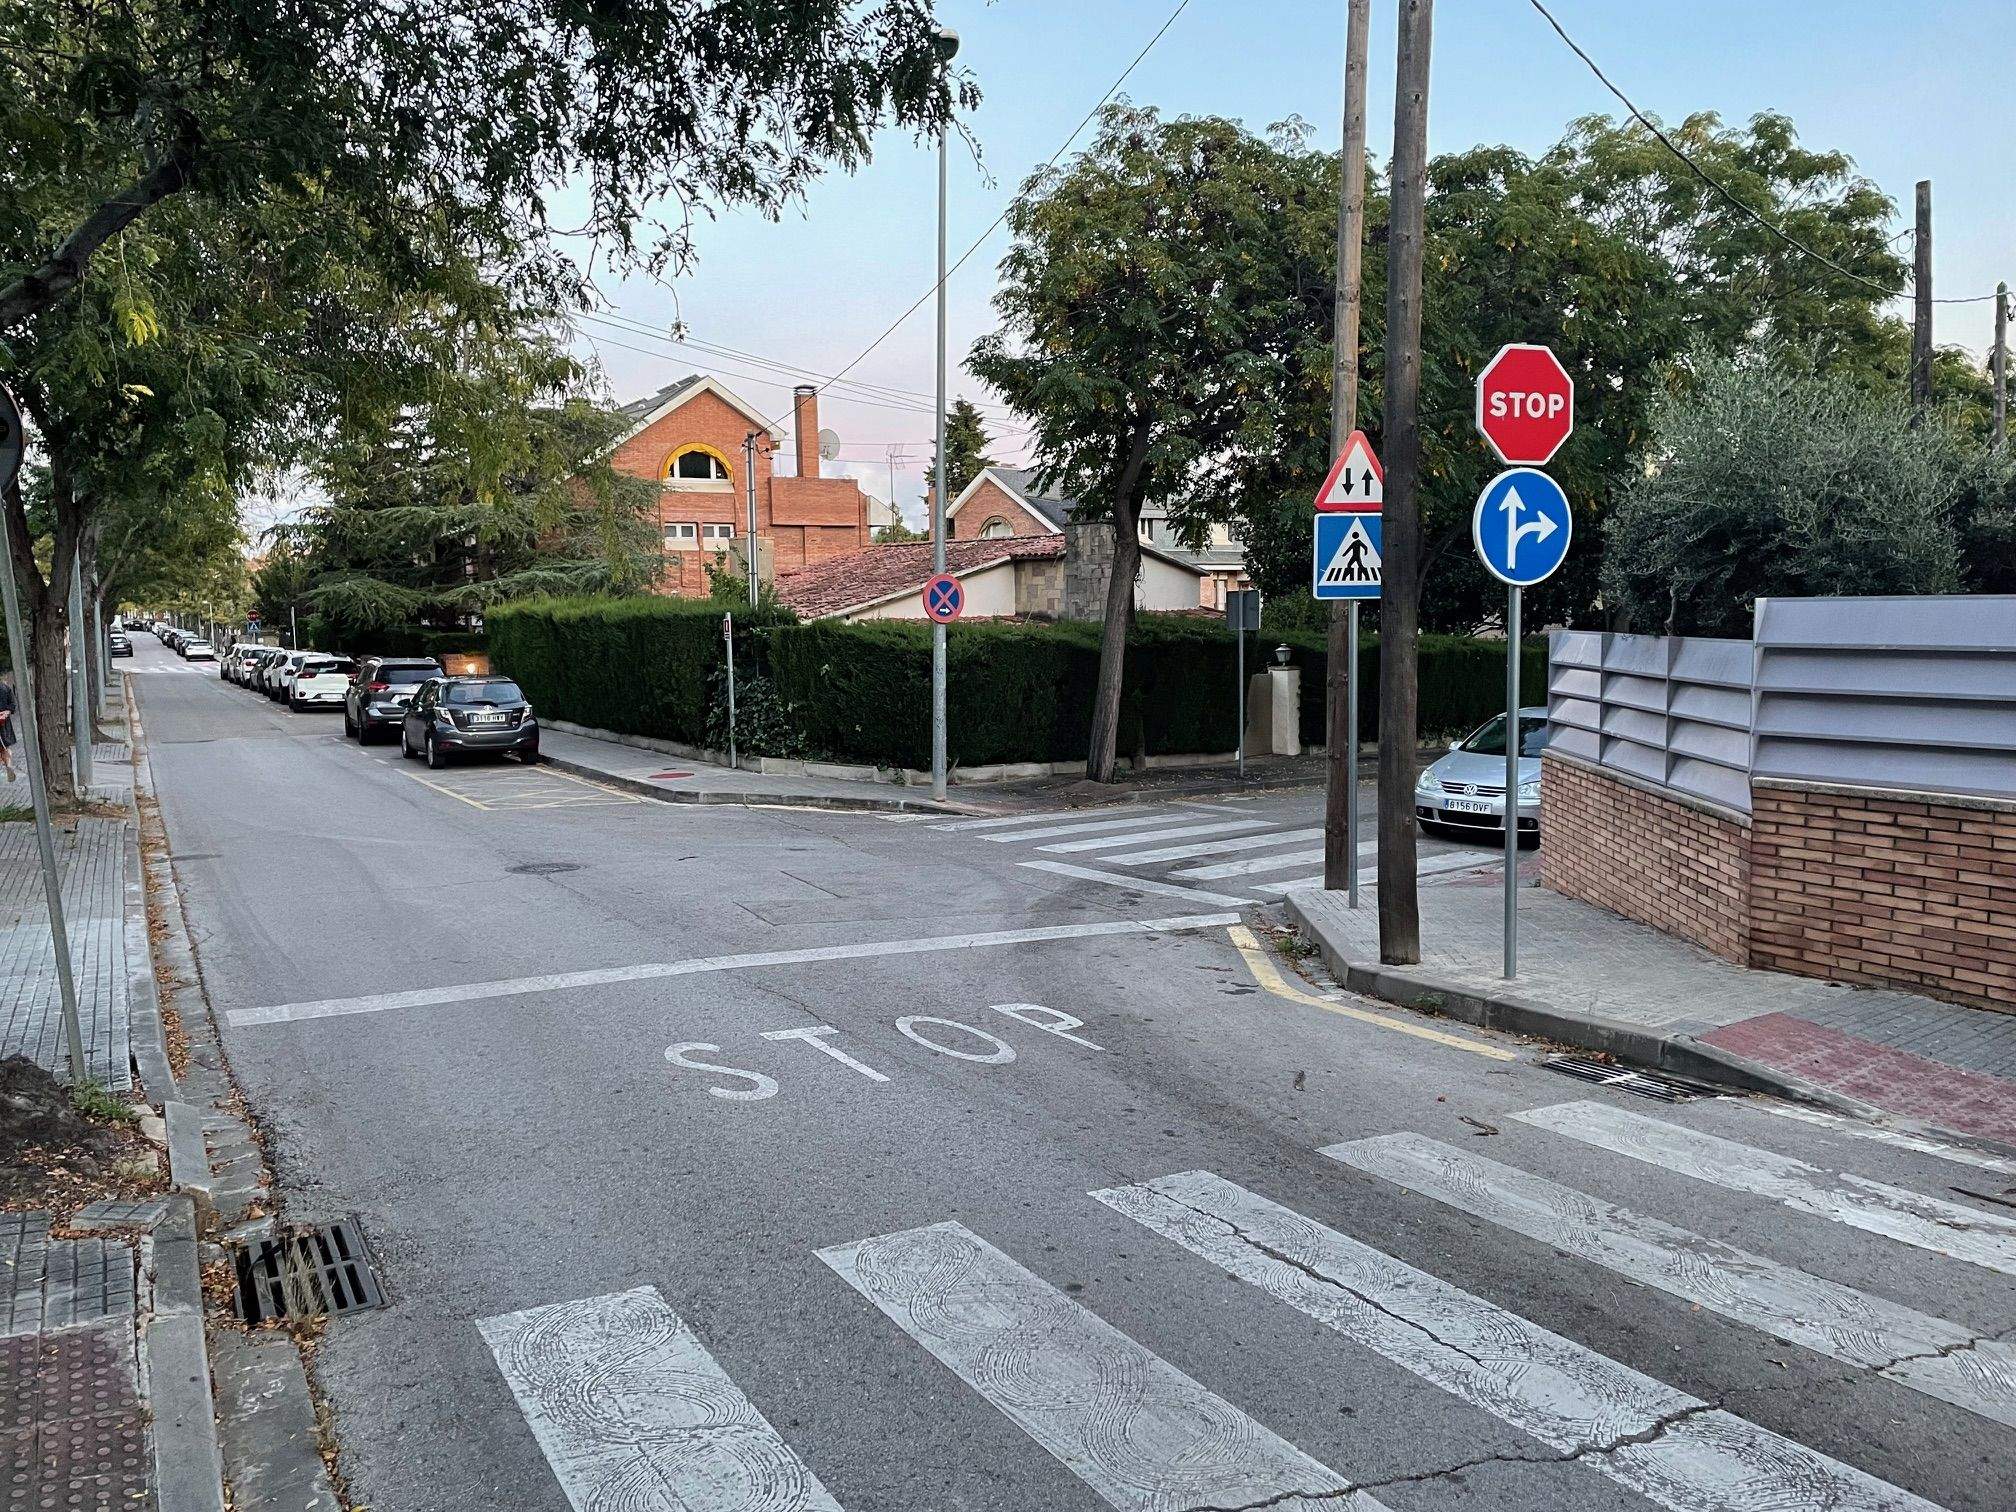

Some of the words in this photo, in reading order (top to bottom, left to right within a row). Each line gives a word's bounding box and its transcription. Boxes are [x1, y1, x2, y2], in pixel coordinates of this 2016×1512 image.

[1489, 391, 1565, 419] STOP
[1449, 801, 1471, 811] 8156
[664, 1003, 1107, 1101] STOP
